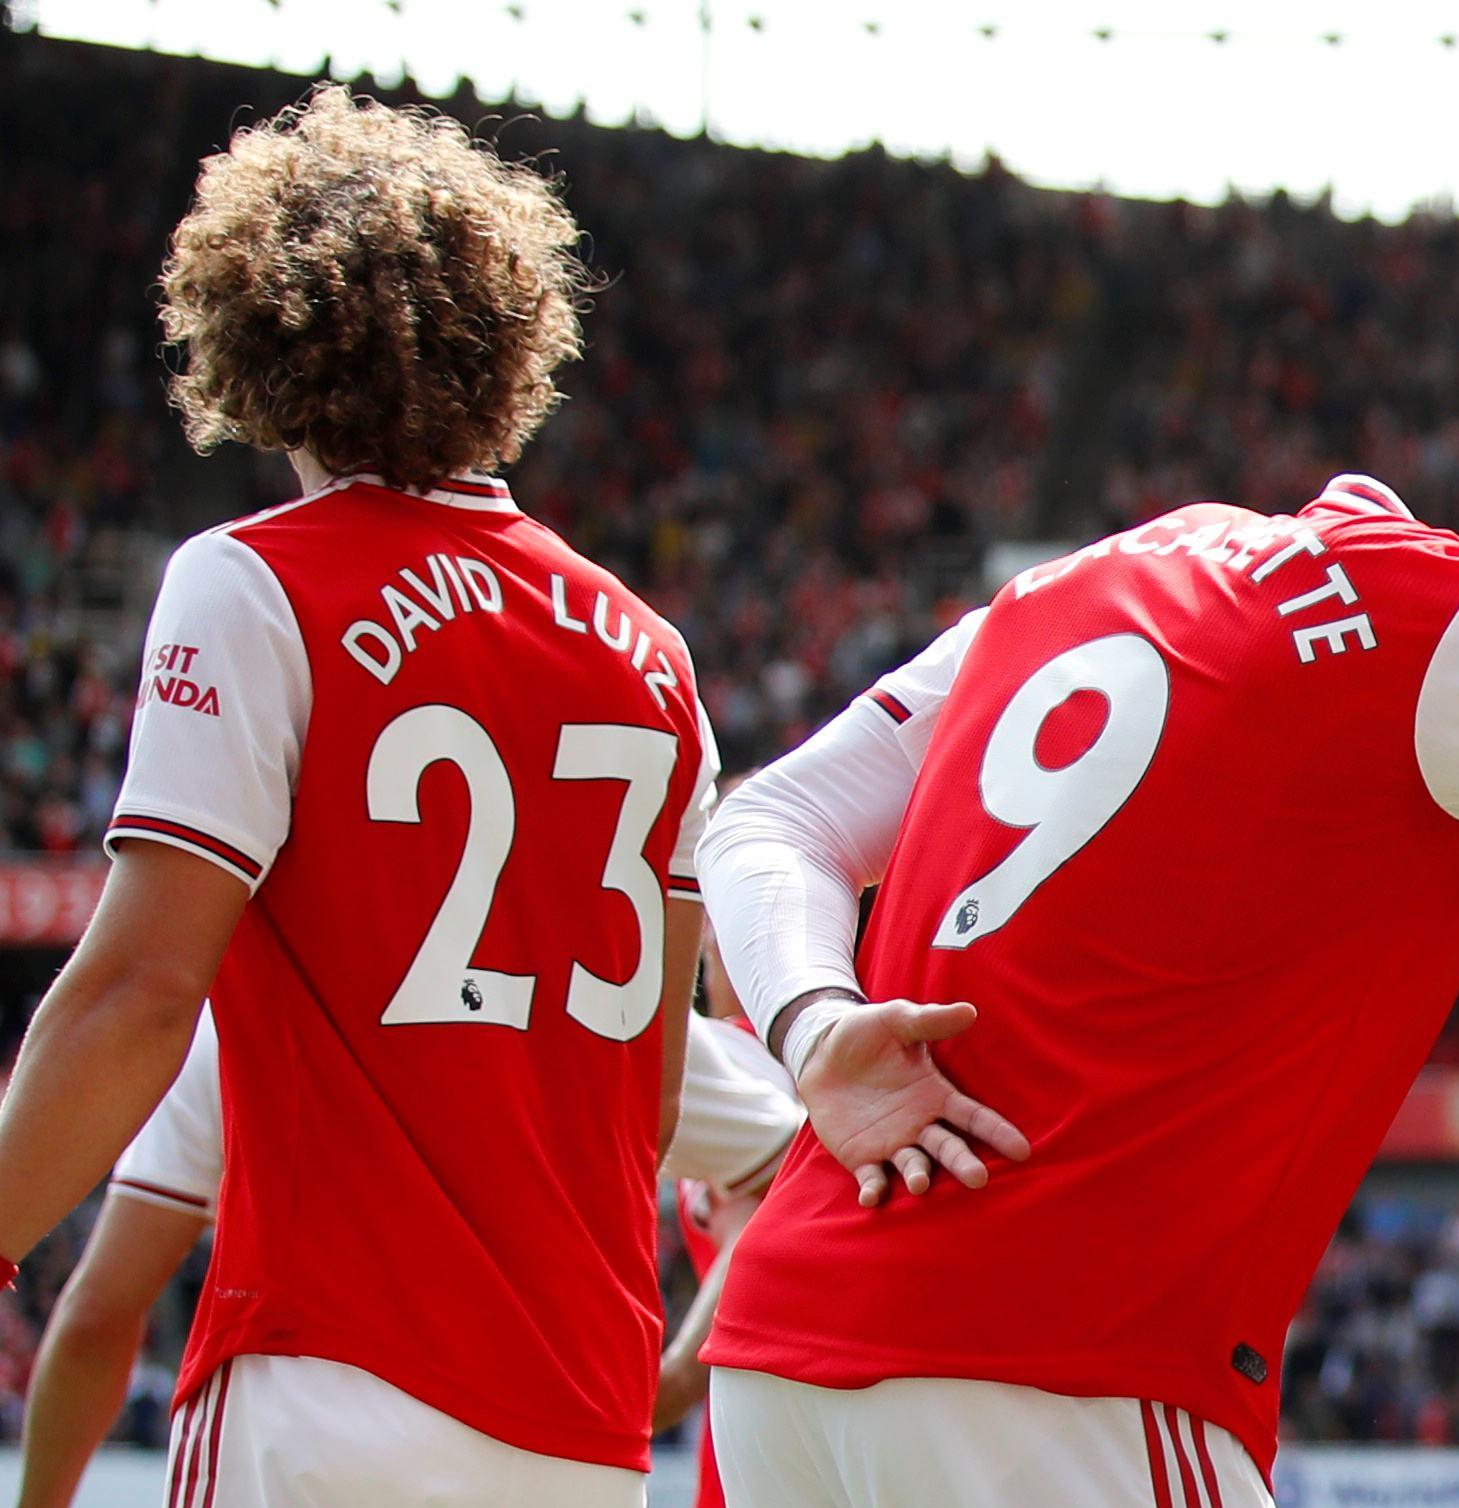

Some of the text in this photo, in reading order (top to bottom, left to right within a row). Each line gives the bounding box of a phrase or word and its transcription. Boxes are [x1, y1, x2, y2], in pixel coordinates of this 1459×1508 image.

[138, 675, 220, 717] NDA
[154, 643, 200, 674] SIT
[340, 553, 678, 711] DAVID LUIZ
[930, 631, 1171, 950] 9
[366, 703, 680, 1043] 23
